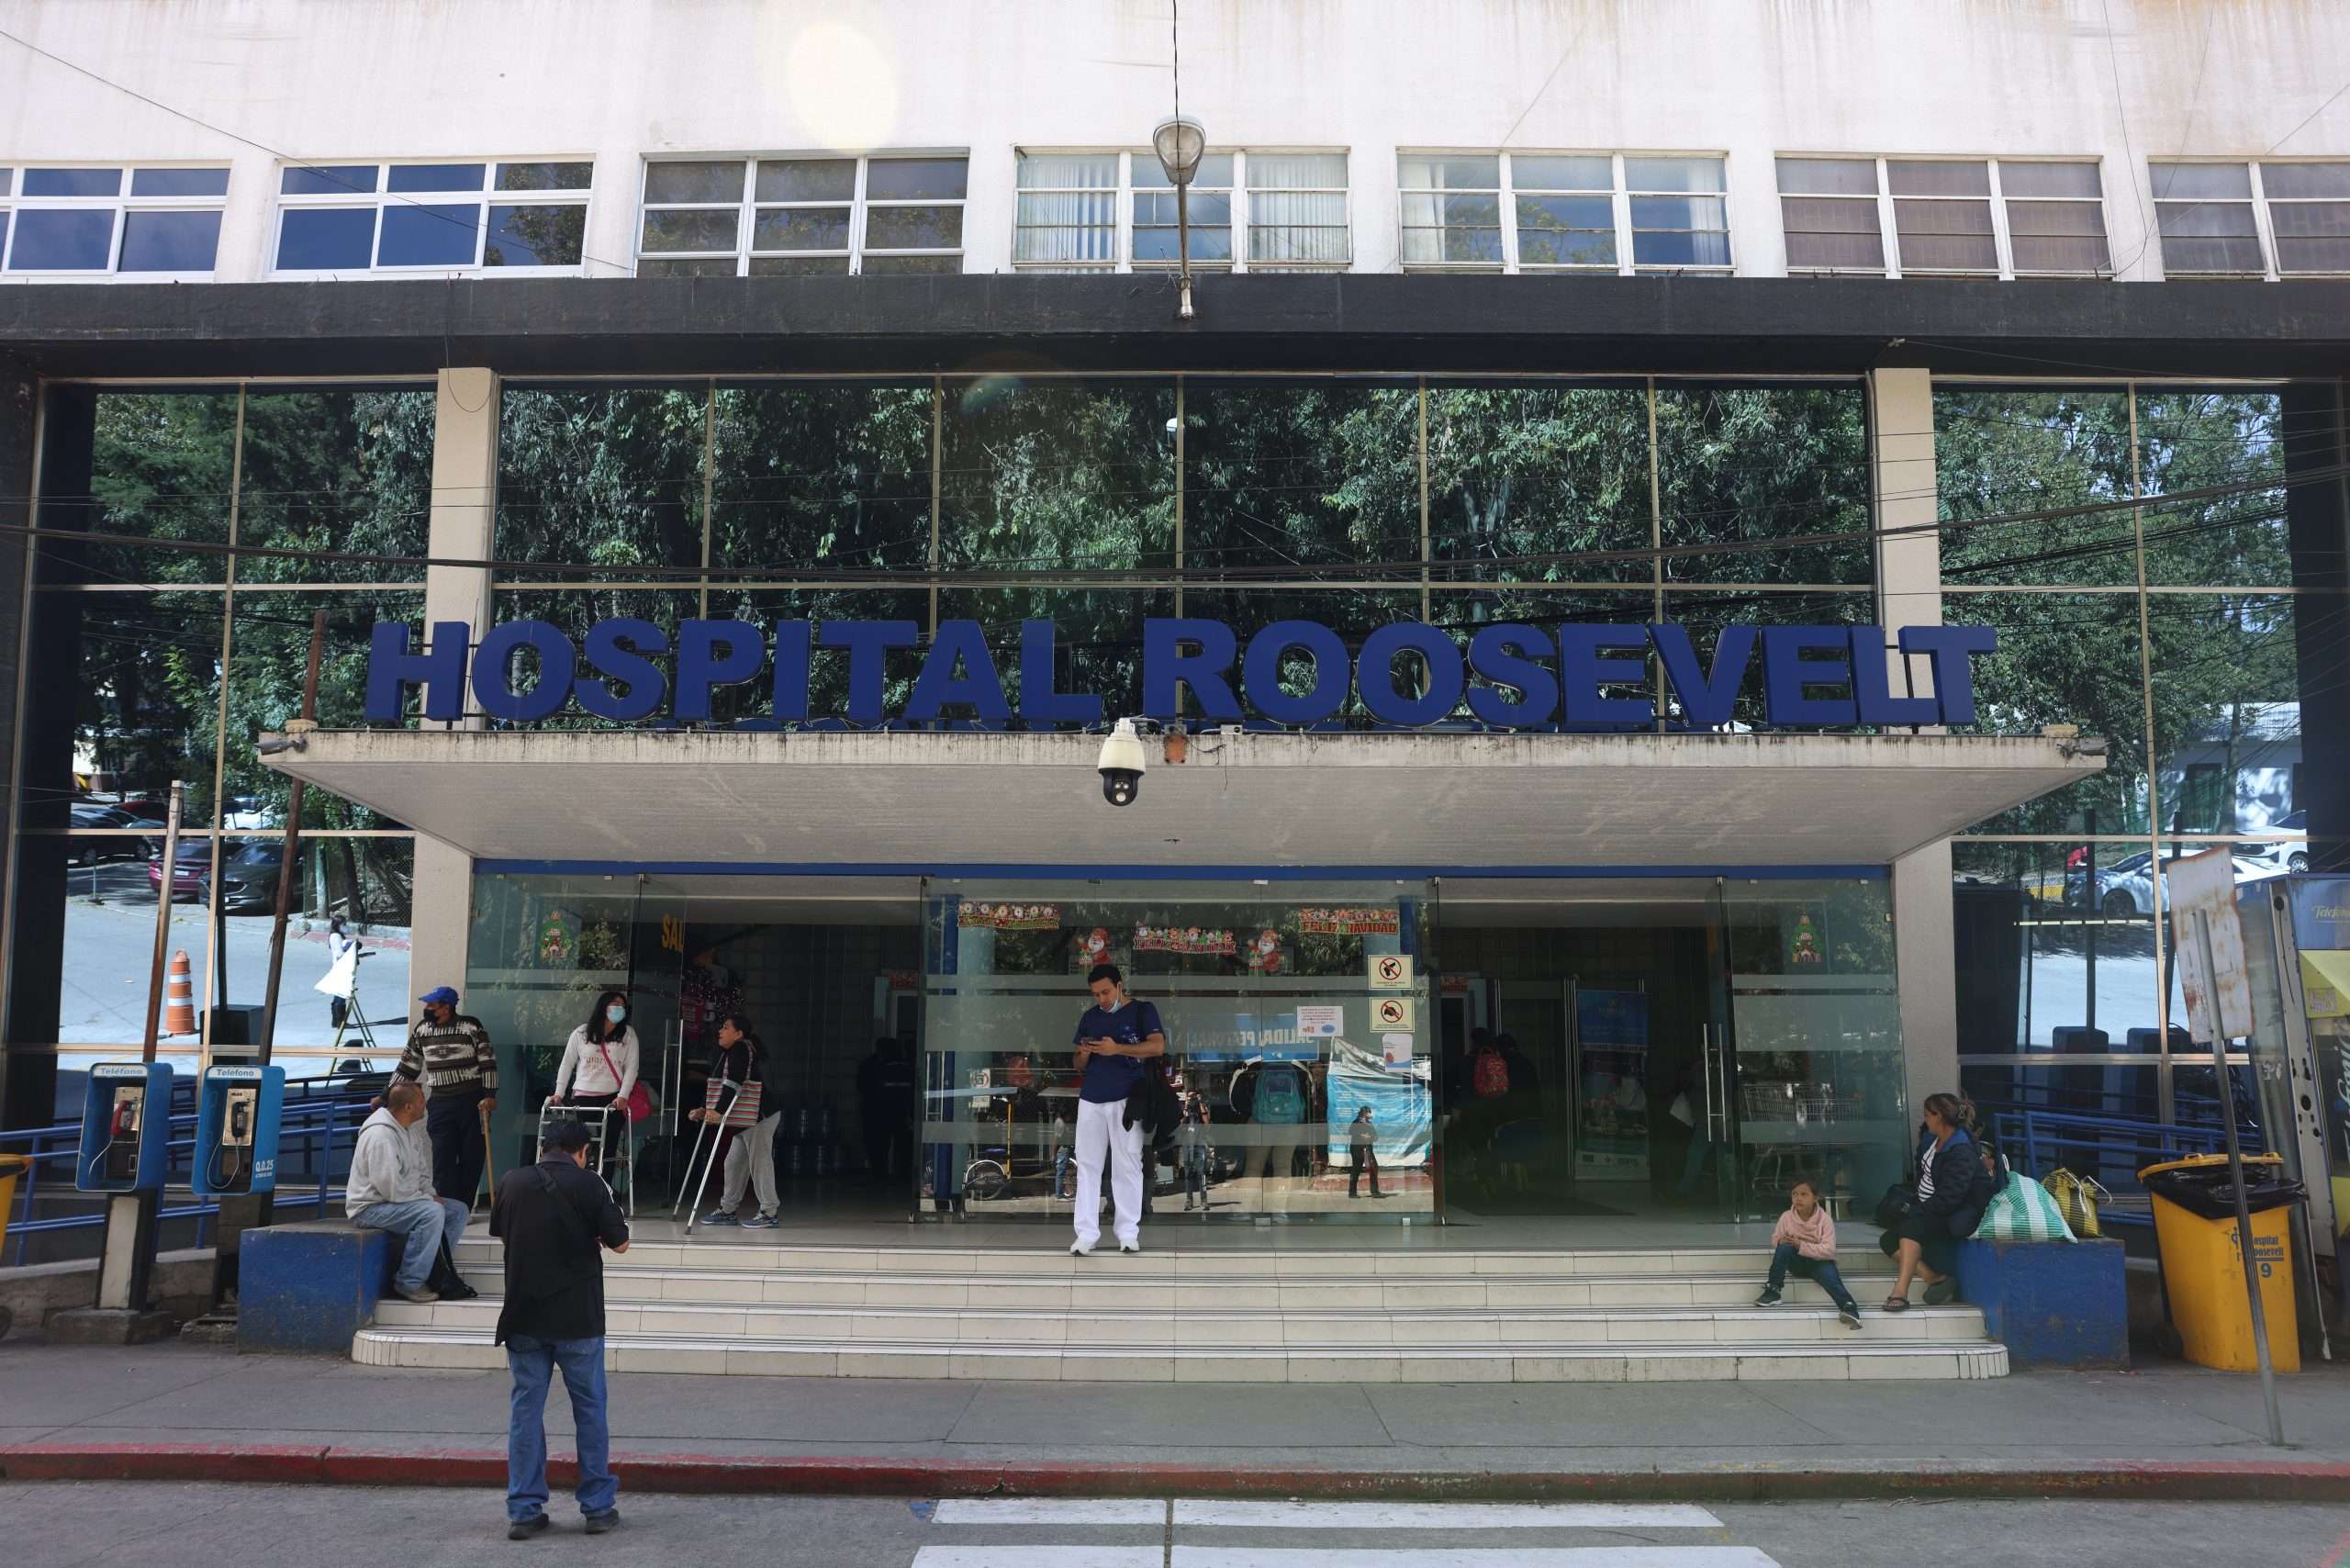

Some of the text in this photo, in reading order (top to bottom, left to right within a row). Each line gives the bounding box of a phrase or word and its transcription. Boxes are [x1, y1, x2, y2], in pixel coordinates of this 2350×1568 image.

[369, 617, 1998, 727] HOSPITAL ROOSEVELT
[1303, 921, 1397, 934] FELIZ NAVIDAD
[217, 1068, 254, 1078] Teléfono
[2254, 1235, 2278, 1246] ospital
[2254, 1247, 2284, 1257] oosevelt
